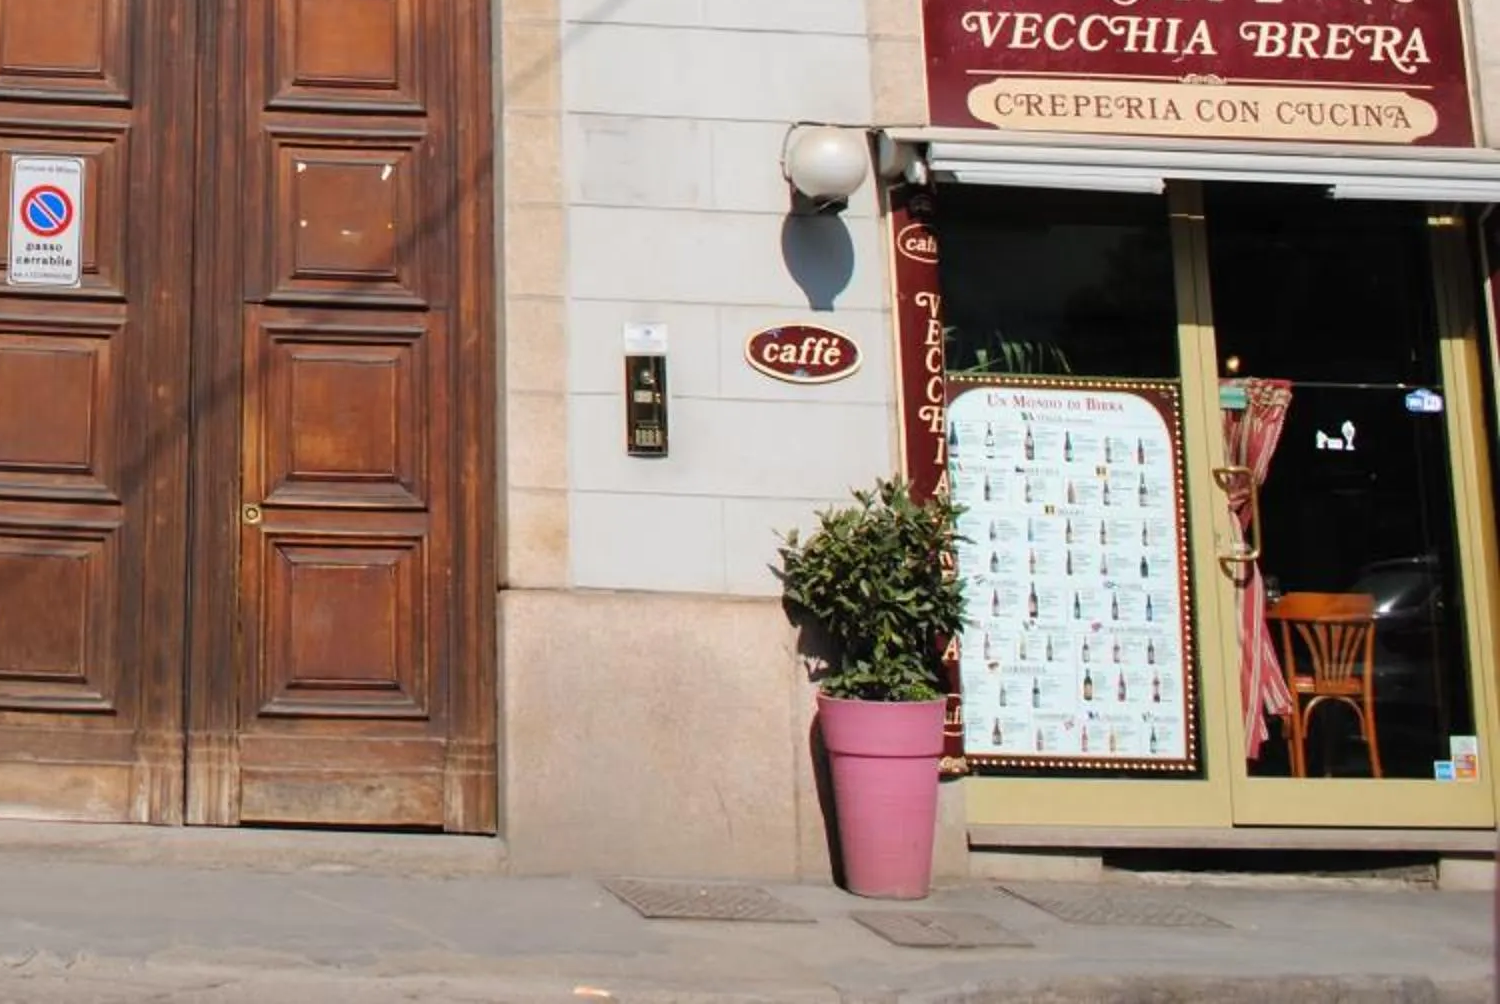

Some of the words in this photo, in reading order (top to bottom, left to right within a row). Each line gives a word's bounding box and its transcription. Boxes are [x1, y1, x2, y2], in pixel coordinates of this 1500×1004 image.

[961, 11, 1218, 62] VECCHIA
[1239, 21, 1431, 74] BRERA
[994, 93, 1183, 122] CREPERIA
[1196, 100, 1261, 124] CON
[1276, 102, 1412, 130] CUCINA
